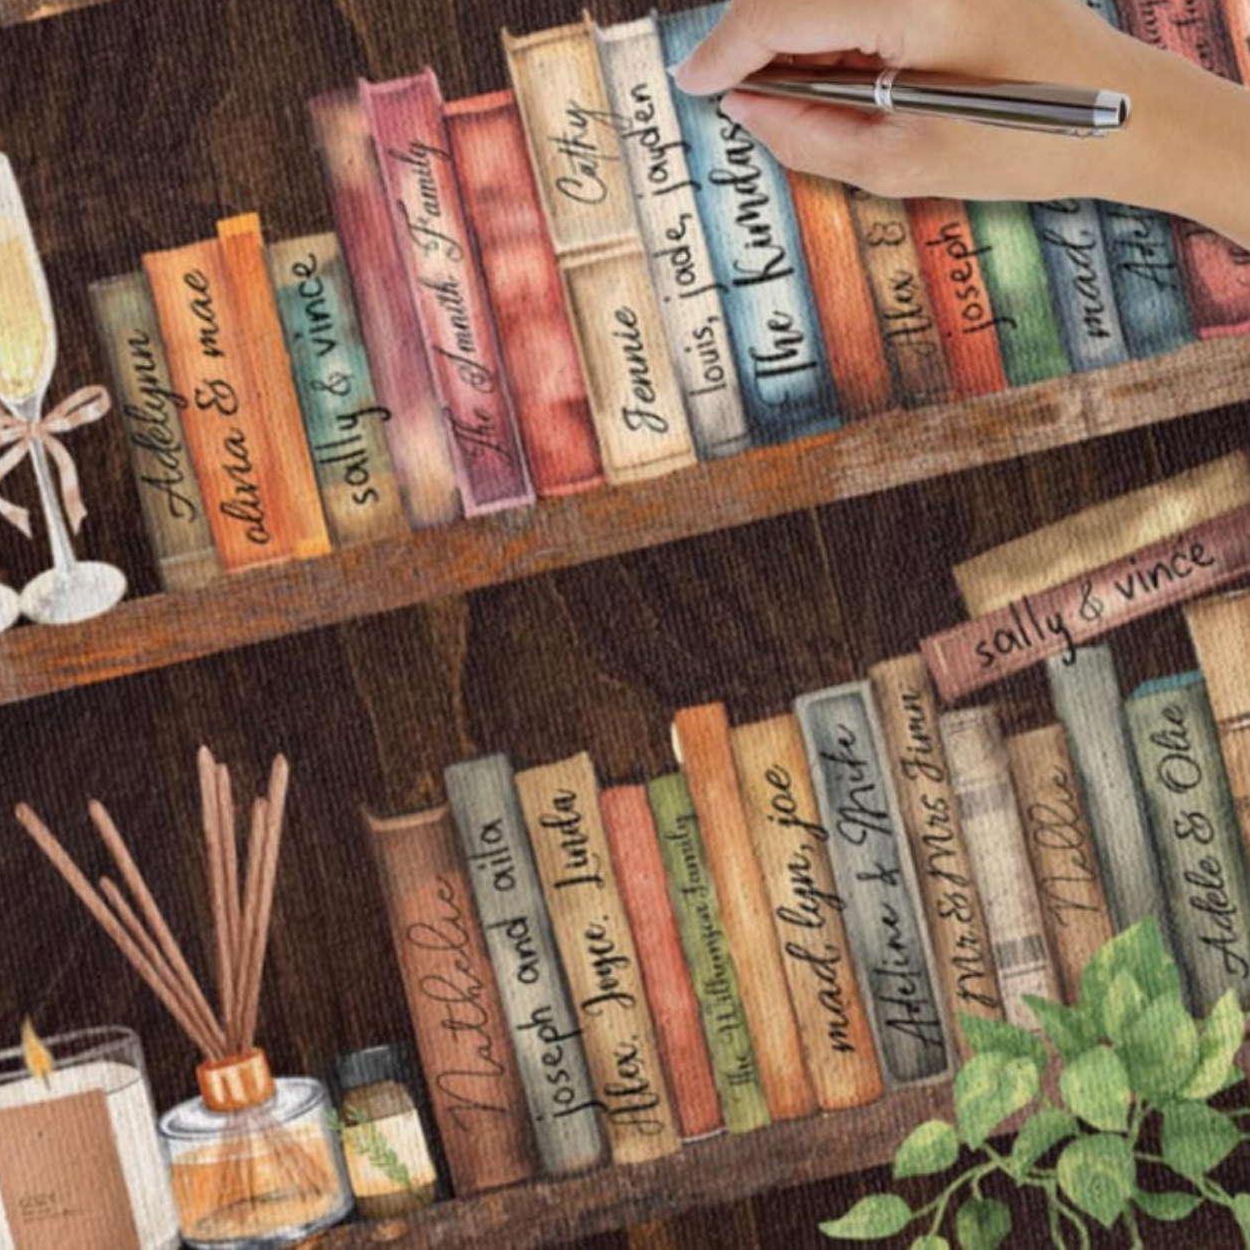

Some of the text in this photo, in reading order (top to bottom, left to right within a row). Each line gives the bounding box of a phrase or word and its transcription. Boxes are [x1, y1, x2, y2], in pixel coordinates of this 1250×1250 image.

[389, 137, 466, 264] Family
[624, 83, 702, 197] jayden
[549, 100, 669, 434] Jennie Cathy
[866, 219, 936, 357] Alex &
[928, 220, 1017, 339] joseph
[182, 268, 270, 546] olivia & mae
[290, 252, 393, 507] sally & vince
[750, 310, 817, 408] The
[124, 329, 198, 524] Adelynn
[441, 400, 515, 461] The
[976, 541, 1217, 668] sally & vince
[539, 788, 606, 890] Linda
[764, 762, 829, 841] joe
[1027, 765, 1099, 927] Nellie
[1174, 810, 1214, 845] &
[819, 722, 945, 1052] Adeline & Mike
[1184, 853, 1250, 980] Adele
[469, 818, 608, 1123] joseph and aila
